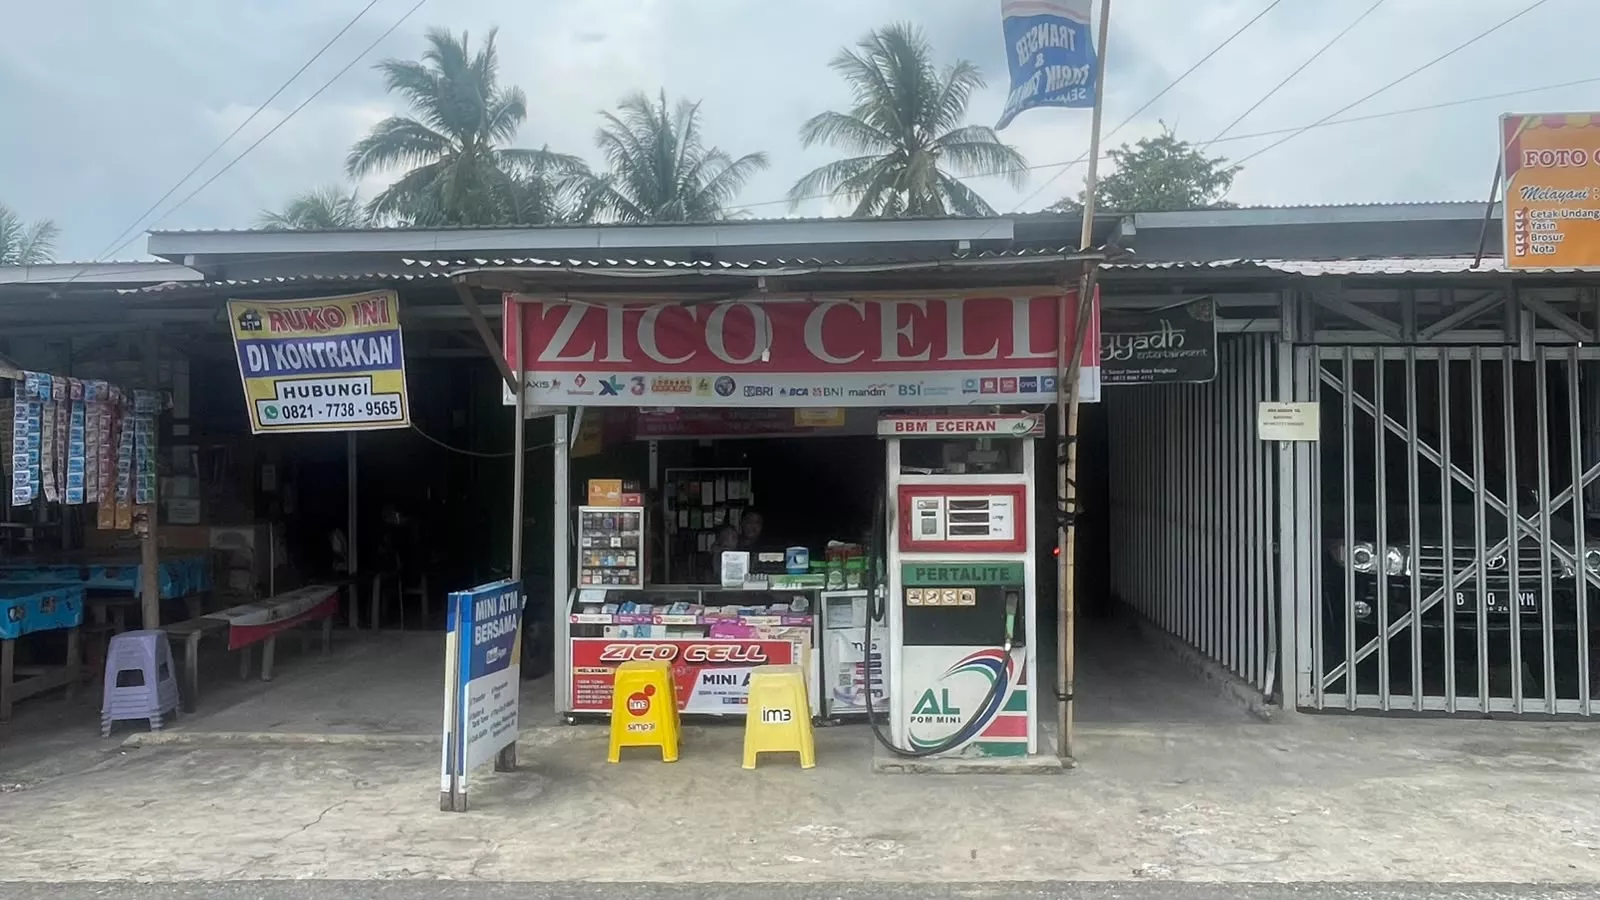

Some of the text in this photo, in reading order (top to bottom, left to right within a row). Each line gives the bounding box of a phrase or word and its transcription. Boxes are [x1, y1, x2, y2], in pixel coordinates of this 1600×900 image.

[1525, 151, 1588, 168] FOTO
[1520, 186, 1589, 203] Melayani
[1531, 209, 1559, 219] Cetak
[1531, 221, 1556, 231] Yasin
[1531, 233, 1564, 243] Brosur
[1531, 245, 1555, 254] Nota
[267, 296, 391, 334] RUKO INI
[537, 296, 1062, 365] ZICO CELL
[246, 336, 394, 373] DI KONTRAKAN
[283, 383, 369, 400] HUBUNGI
[526, 381, 550, 389] AXIS
[755, 386, 774, 397] BRI
[789, 386, 809, 397] BCA
[824, 386, 844, 397] BNI
[898, 384, 922, 396] BSI
[282, 403, 314, 420] 0821
[326, 403, 354, 418] 7738
[366, 401, 398, 417] 9565
[896, 421, 928, 433] BBM
[936, 420, 996, 433] ECERAN
[916, 567, 1010, 582] PERTALITE
[475, 597, 497, 622] MINI
[499, 591, 518, 615] ATM
[1456, 592, 1465, 606] B
[475, 613, 518, 646] BERSAMA
[600, 643, 769, 663] ZICO CELL
[703, 673, 737, 686] MINI
[911, 688, 961, 715] AL
[762, 706, 792, 722] im3
[910, 716, 961, 724] POM MINI
